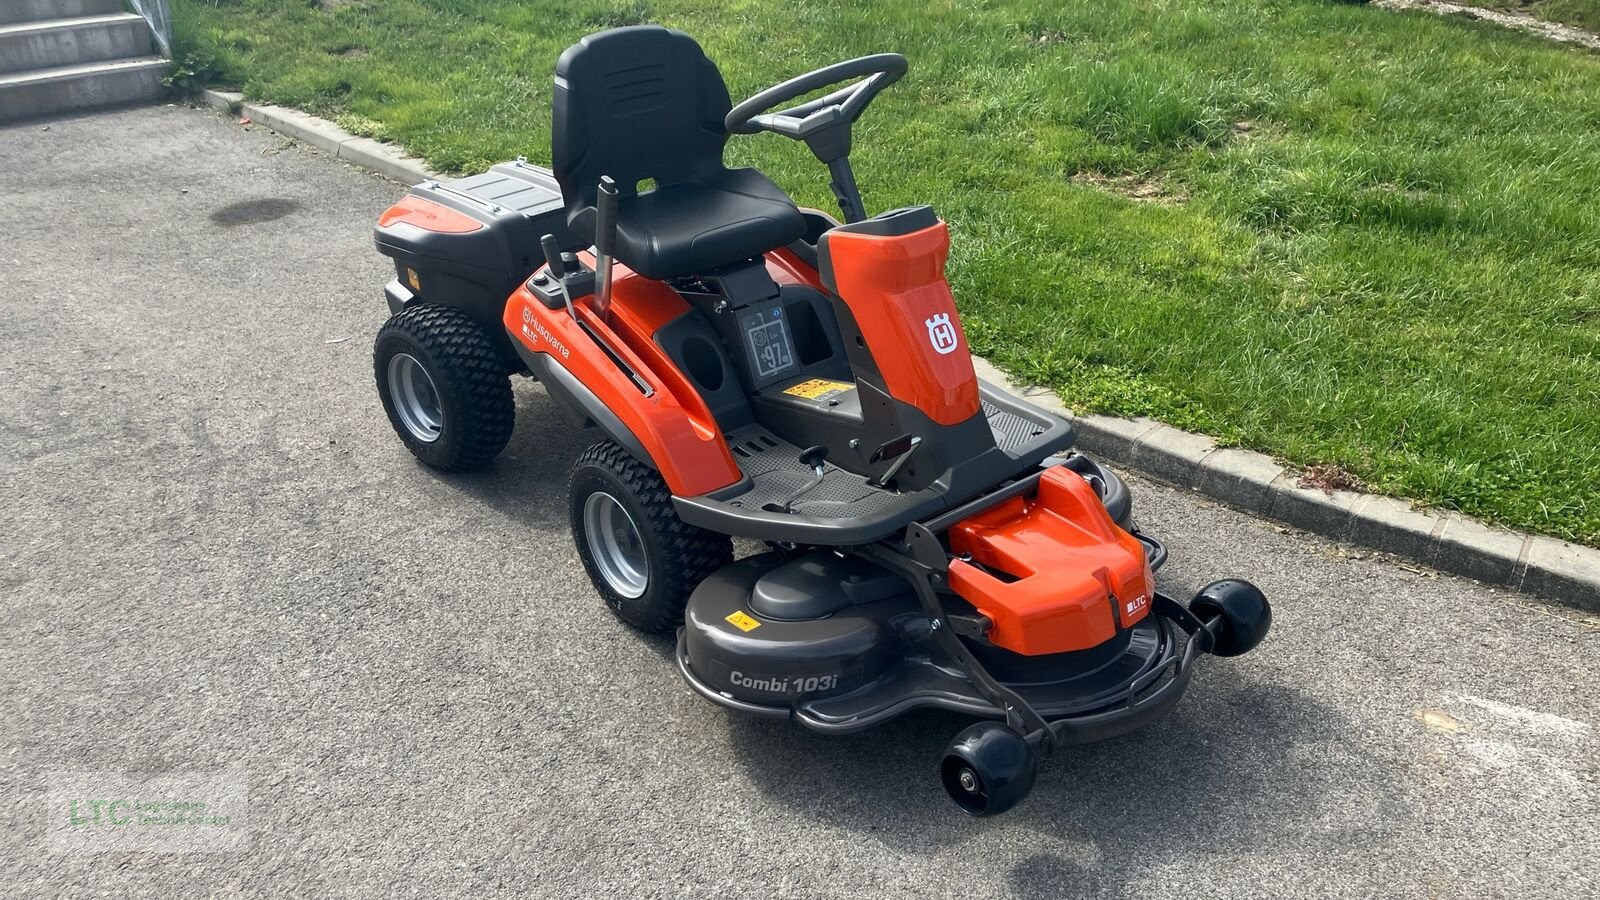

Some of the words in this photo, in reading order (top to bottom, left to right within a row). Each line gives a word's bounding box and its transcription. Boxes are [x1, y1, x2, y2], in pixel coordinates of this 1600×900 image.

[526, 329, 538, 343] LTC
[529, 314, 570, 359] Husqvarna
[765, 342, 782, 368] 97
[1132, 594, 1147, 609] LTC
[730, 671, 789, 692] Combi
[792, 674, 839, 693] 103i
